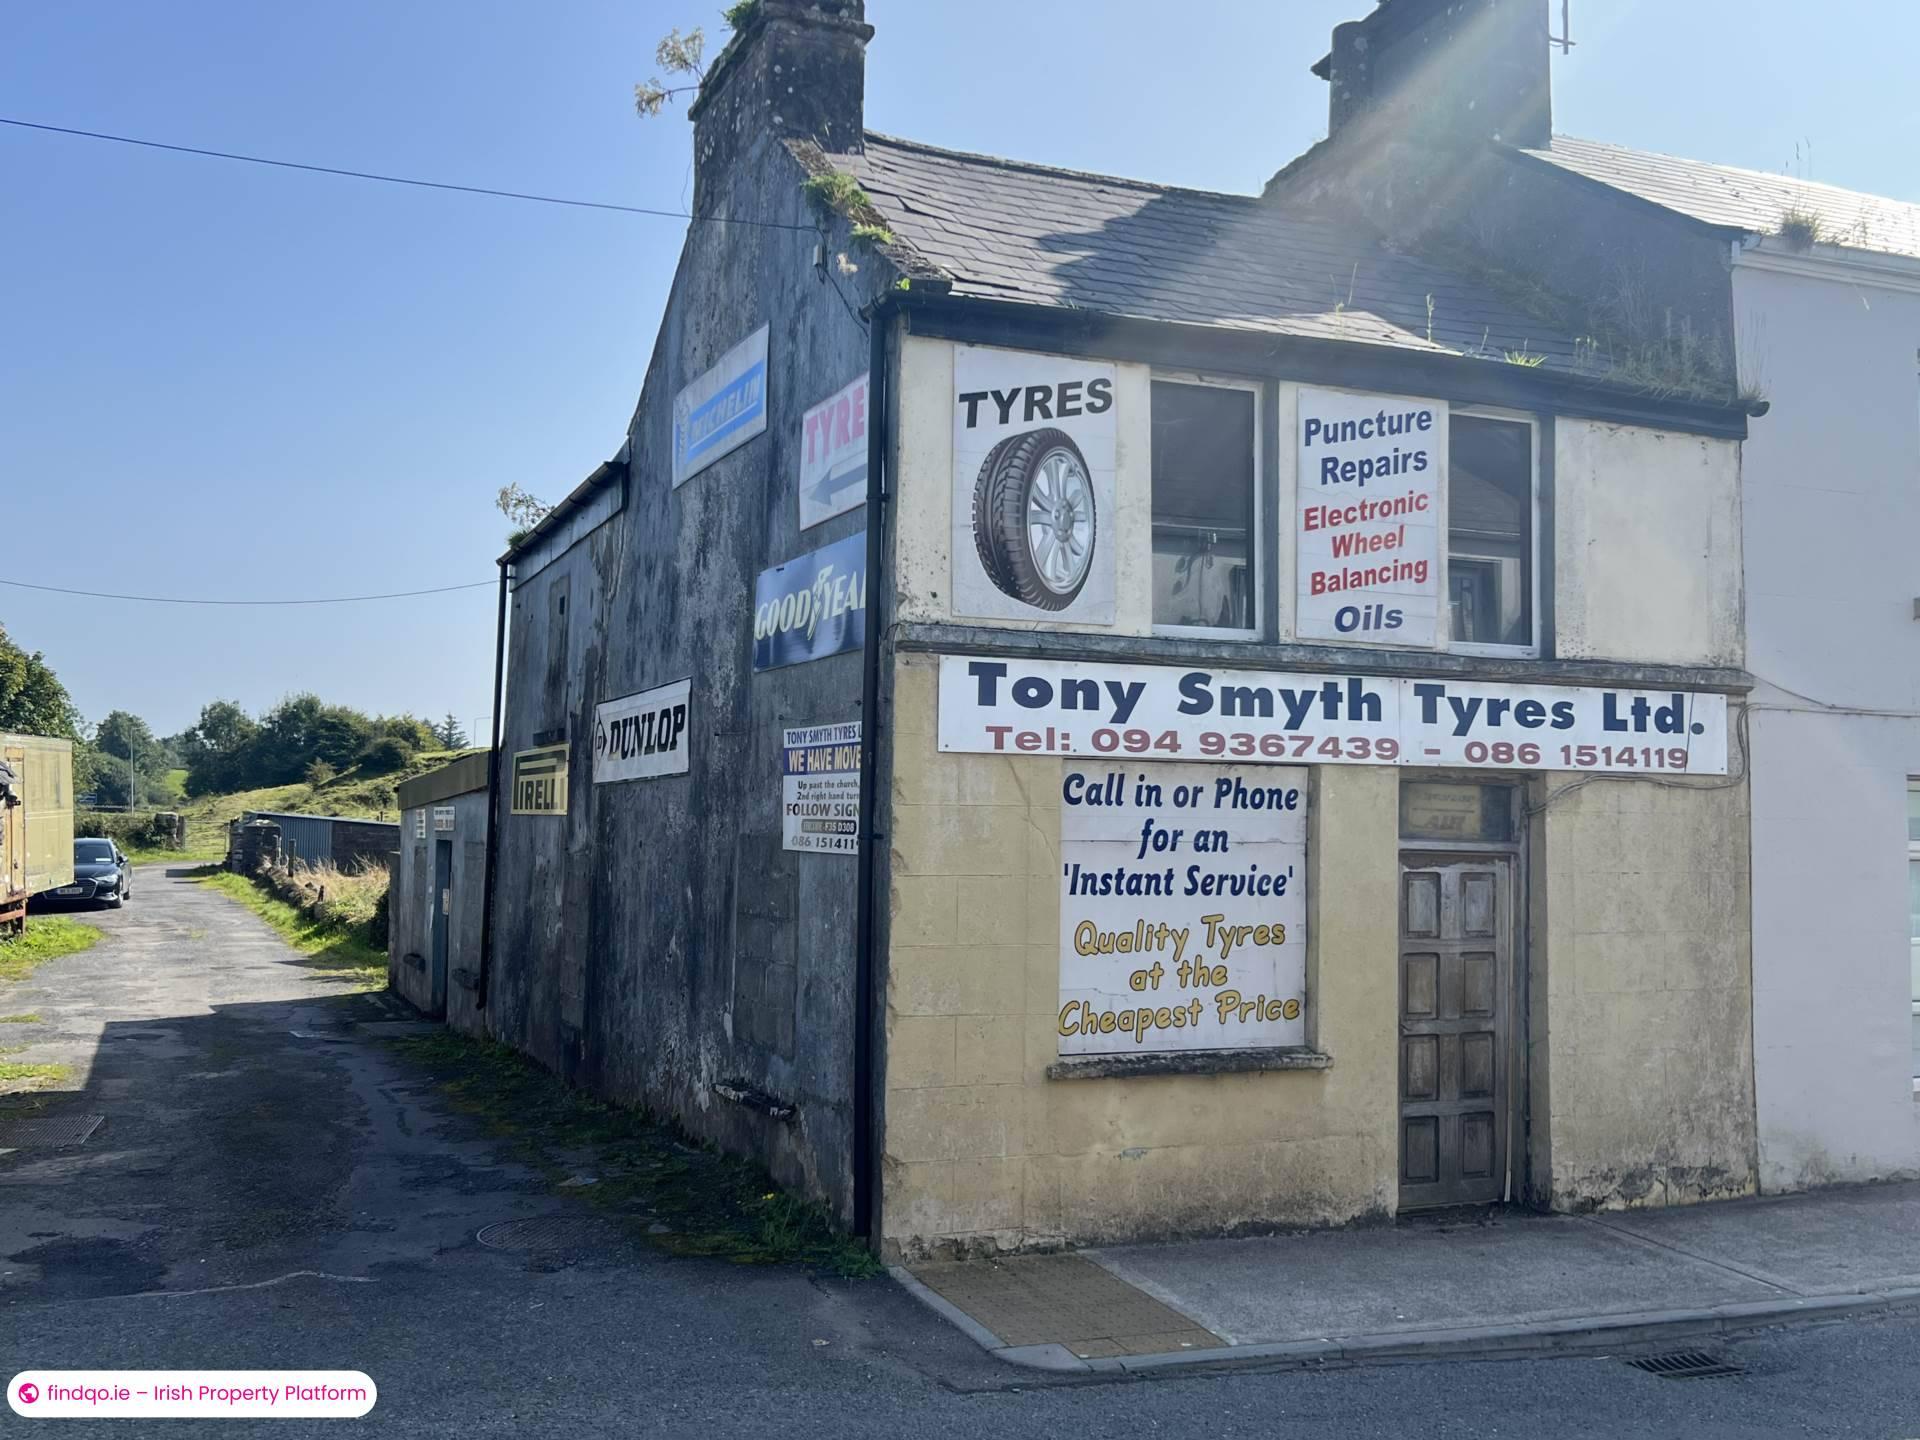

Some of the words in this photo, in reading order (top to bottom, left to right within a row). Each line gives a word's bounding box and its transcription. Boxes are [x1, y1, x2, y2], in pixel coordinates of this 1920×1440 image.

[958, 378, 1113, 429] TYRES
[805, 383, 867, 465] TYRE
[1304, 410, 1432, 447] Puncture
[1321, 447, 1428, 487] Repairs
[1303, 490, 1429, 532] Electronic
[1331, 525, 1405, 559] Wheel
[1311, 559, 1428, 596] Balancing
[1334, 604, 1404, 633] Oils
[968, 661, 1147, 724] Tony
[1176, 672, 1382, 730] Smyth
[1414, 683, 1575, 737] Tyres
[1602, 692, 1705, 735] Ltd.
[608, 704, 686, 761] DUNLOP
[786, 730, 808, 745] TONY
[809, 727, 832, 744] SMYTH
[834, 724, 856, 741] TYRES
[985, 726, 1071, 751] Tel:
[1091, 728, 1182, 754] 094
[1199, 732, 1399, 761] 9367439
[1464, 741, 1541, 765] 086
[1560, 745, 1688, 769] 1514119
[788, 749, 805, 772] WE
[807, 747, 832, 772] HAVE
[834, 745, 861, 770] MOVE
[797, 781, 808, 790] Up
[809, 781, 822, 790] past
[824, 780, 835, 789] the
[797, 791, 809, 800] 2nd
[811, 791, 826, 802] right
[828, 791, 844, 800] hand
[1063, 773, 1126, 807] Call
[1134, 774, 1162, 808] in
[1173, 784, 1204, 808] or
[1214, 776, 1298, 811] Phone
[786, 803, 830, 817] FOLLOW
[834, 803, 860, 817] SIGN
[791, 836, 811, 847] 086
[1137, 818, 1184, 859] for
[1193, 828, 1229, 853] an
[1064, 863, 1174, 896] 'Instant
[1184, 864, 1293, 896] Service'
[1074, 919, 1189, 962] Quality
[1201, 914, 1286, 959] Tyres
[1129, 961, 1164, 991] at
[1177, 954, 1228, 988] the
[1058, 998, 1203, 1043] Cheapest
[1215, 990, 1300, 1024] Price
